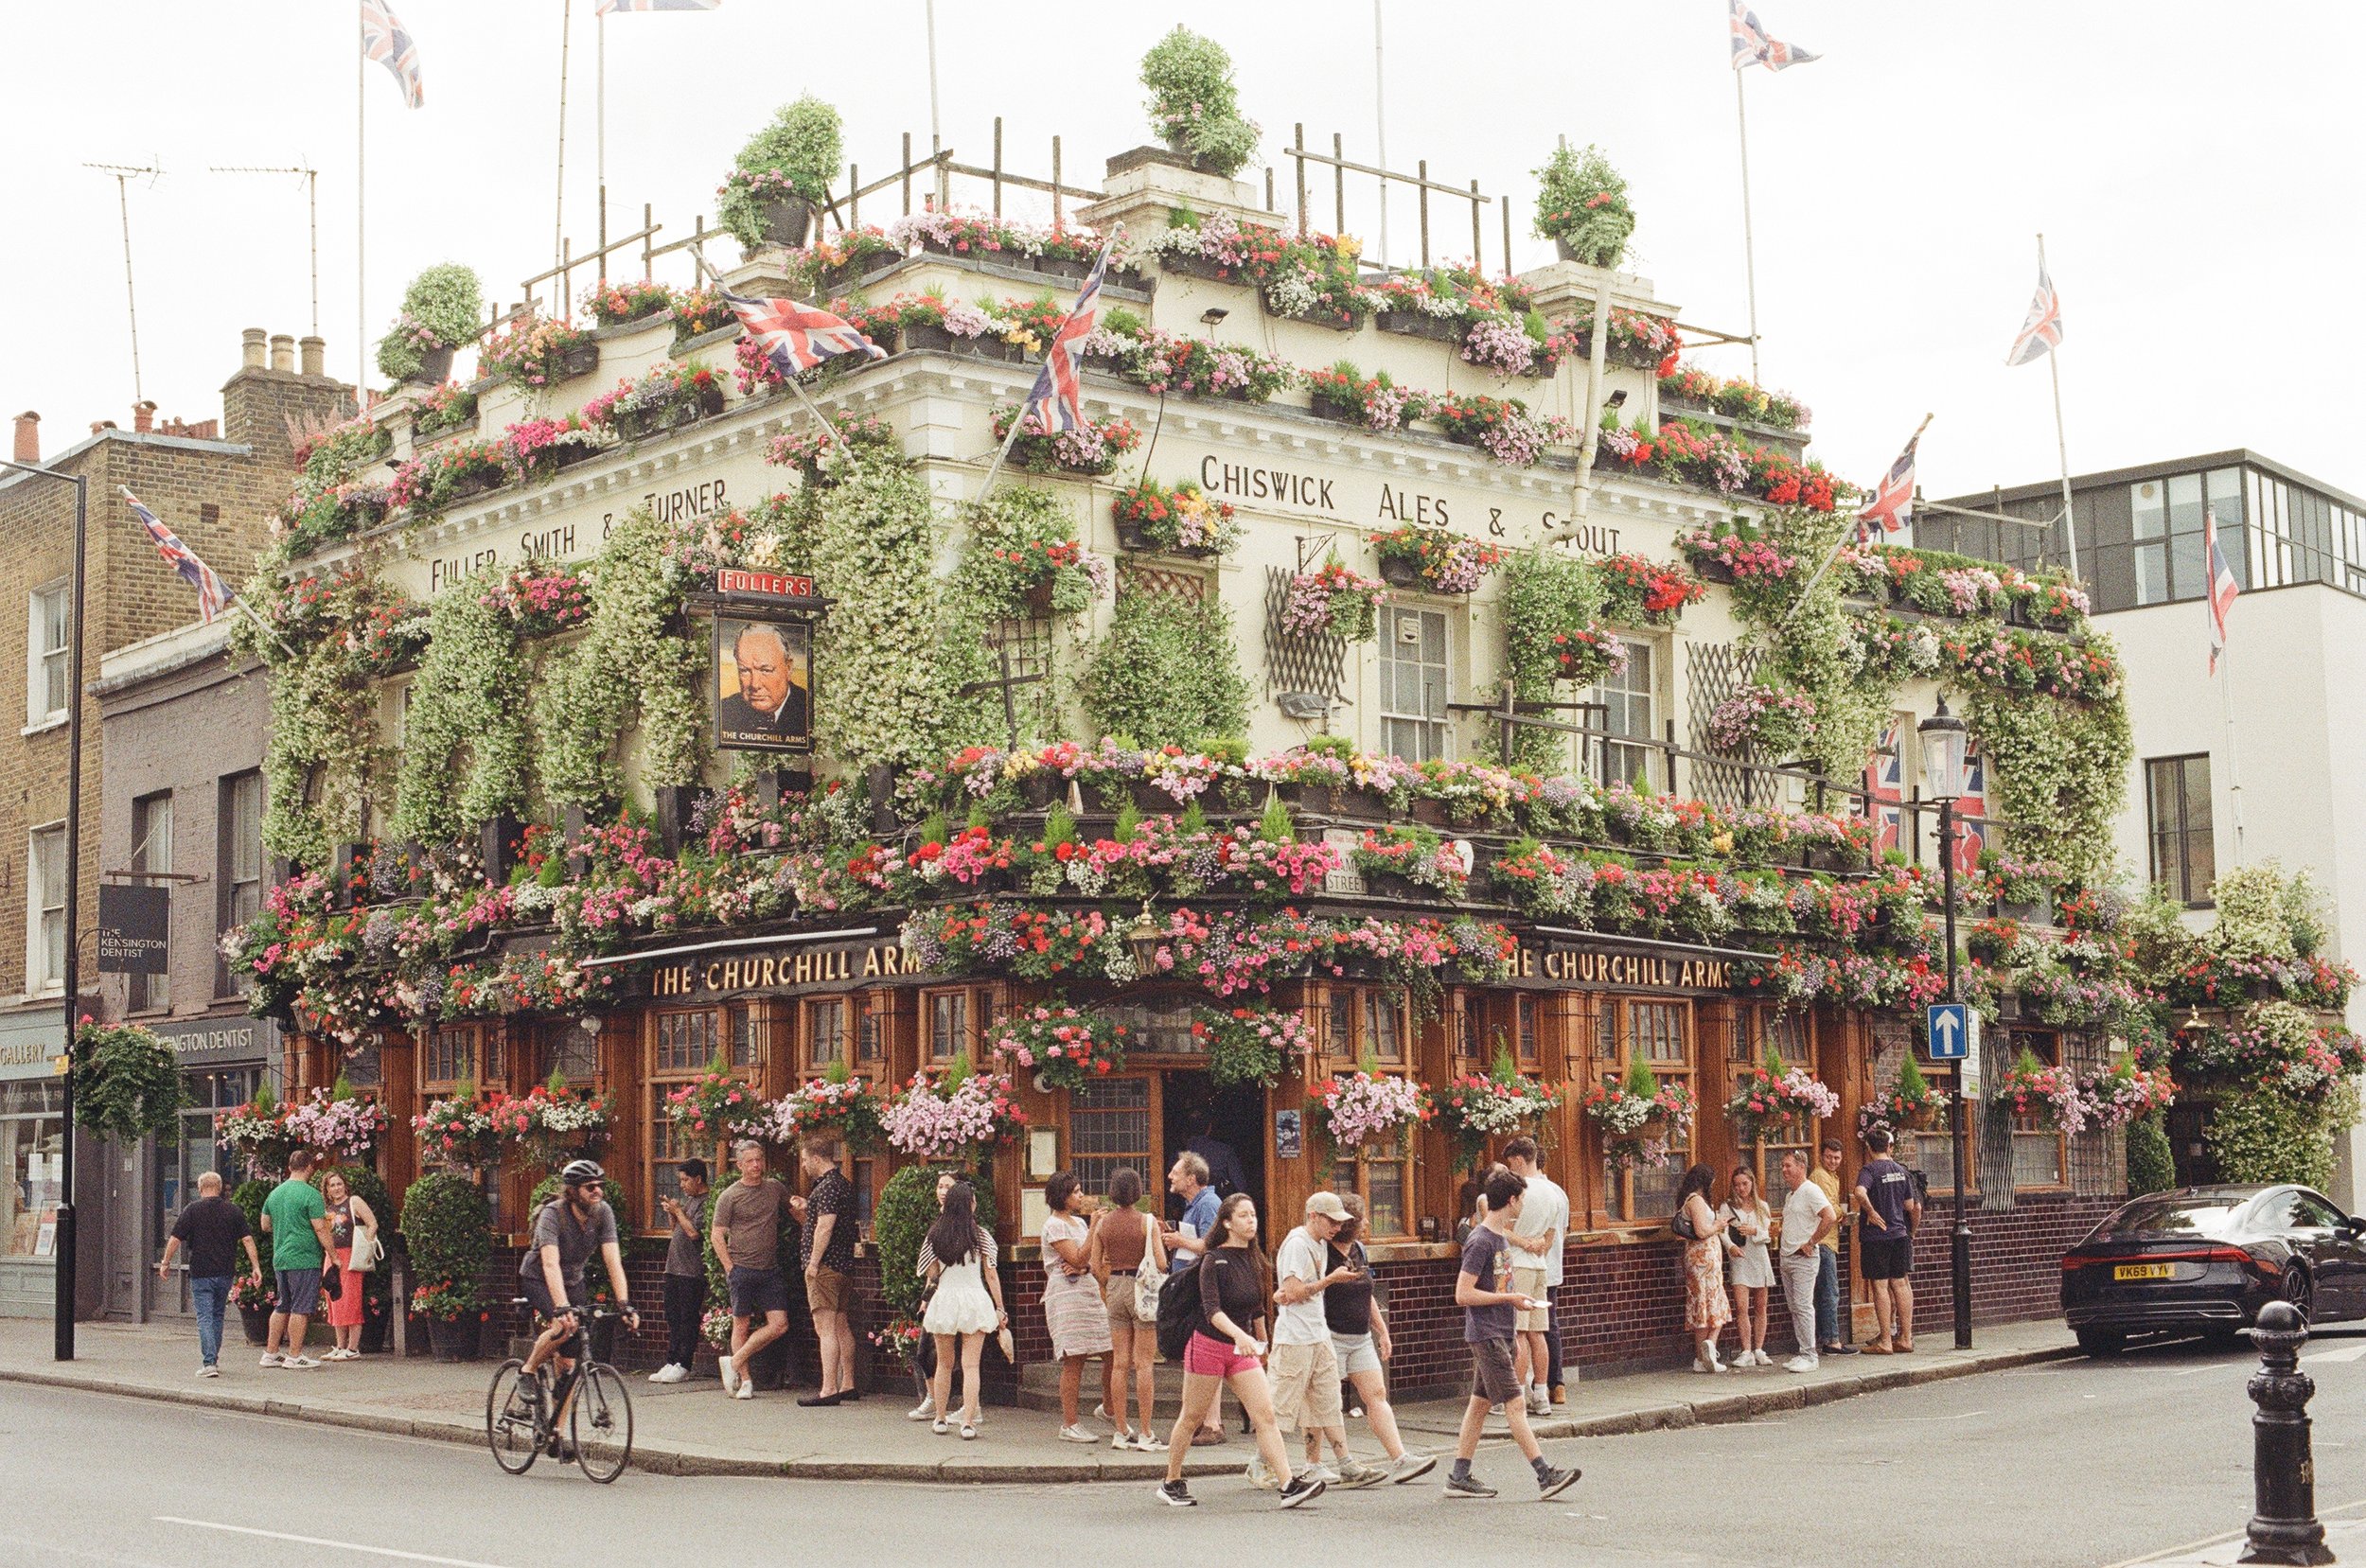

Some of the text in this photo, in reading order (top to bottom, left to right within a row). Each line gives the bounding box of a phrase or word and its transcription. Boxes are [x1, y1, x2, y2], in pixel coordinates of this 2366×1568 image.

[1201, 455, 1334, 510] CHISWICK
[1379, 484, 1449, 527] ALES
[1489, 508, 1506, 537] &
[521, 524, 574, 560] SMITH
[603, 513, 613, 540] &
[644, 480, 726, 523] TURNER
[722, 731, 806, 744] THE CHURCHILL ARMS
[1328, 873, 1366, 892] STREET
[100, 947, 143, 958] DENTIST
[101, 938, 167, 949] KENSINGTON
[653, 945, 921, 995] THE CHURCHILL ARM
[1506, 948, 1732, 989] HE CHURCHILL ARMS
[209, 1028, 253, 1049] DENTIST
[0, 1044, 45, 1066] GALLERY
[2120, 1266, 2147, 1277] VK69
